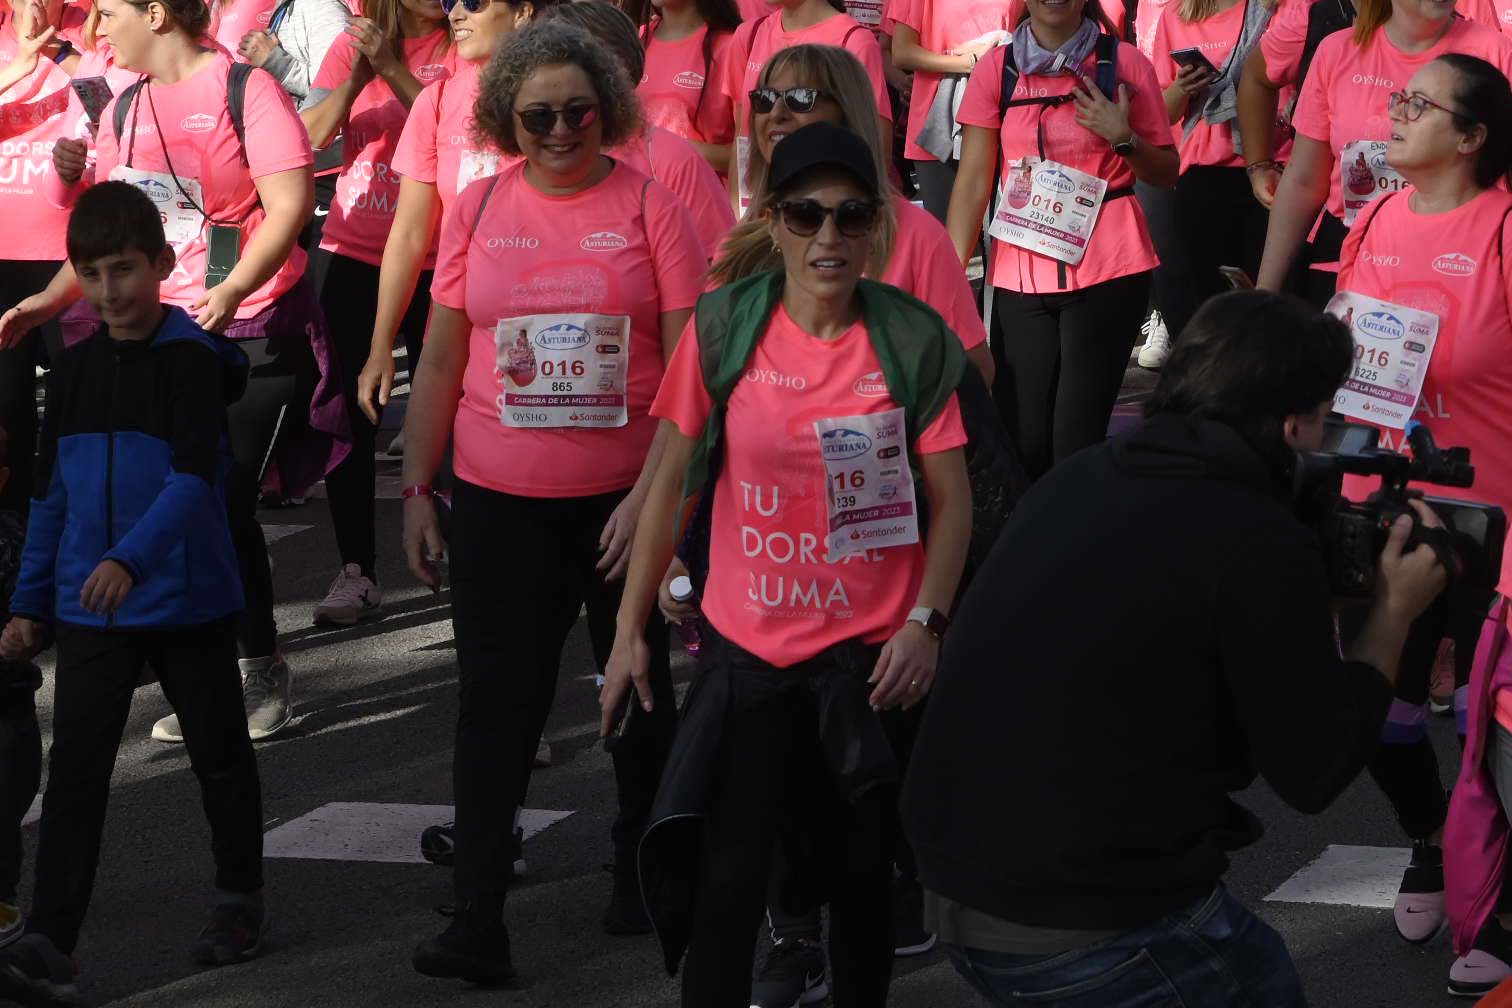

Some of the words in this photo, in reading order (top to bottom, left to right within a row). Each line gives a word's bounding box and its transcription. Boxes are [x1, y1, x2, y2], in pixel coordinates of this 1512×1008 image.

[1352, 73, 1394, 89] OYSHO
[1032, 193, 1065, 215] 016
[1029, 211, 1056, 225] 23140
[487, 235, 541, 250] OYSHO
[1362, 250, 1401, 267] OYSHO
[1360, 318, 1401, 338] ASTURIANA
[540, 334, 587, 345] ASTURIANA
[541, 360, 585, 377] 016
[551, 381, 573, 392] 865
[746, 368, 807, 391] OYSHO
[514, 396, 546, 404] CARRERA
[560, 396, 570, 404] LA
[571, 396, 597, 404] MUJER
[512, 412, 547, 422] OYSHO
[579, 412, 619, 422] Santander
[740, 480, 780, 517] TU
[860, 525, 907, 540] Santander
[748, 571, 850, 610] SUMA
